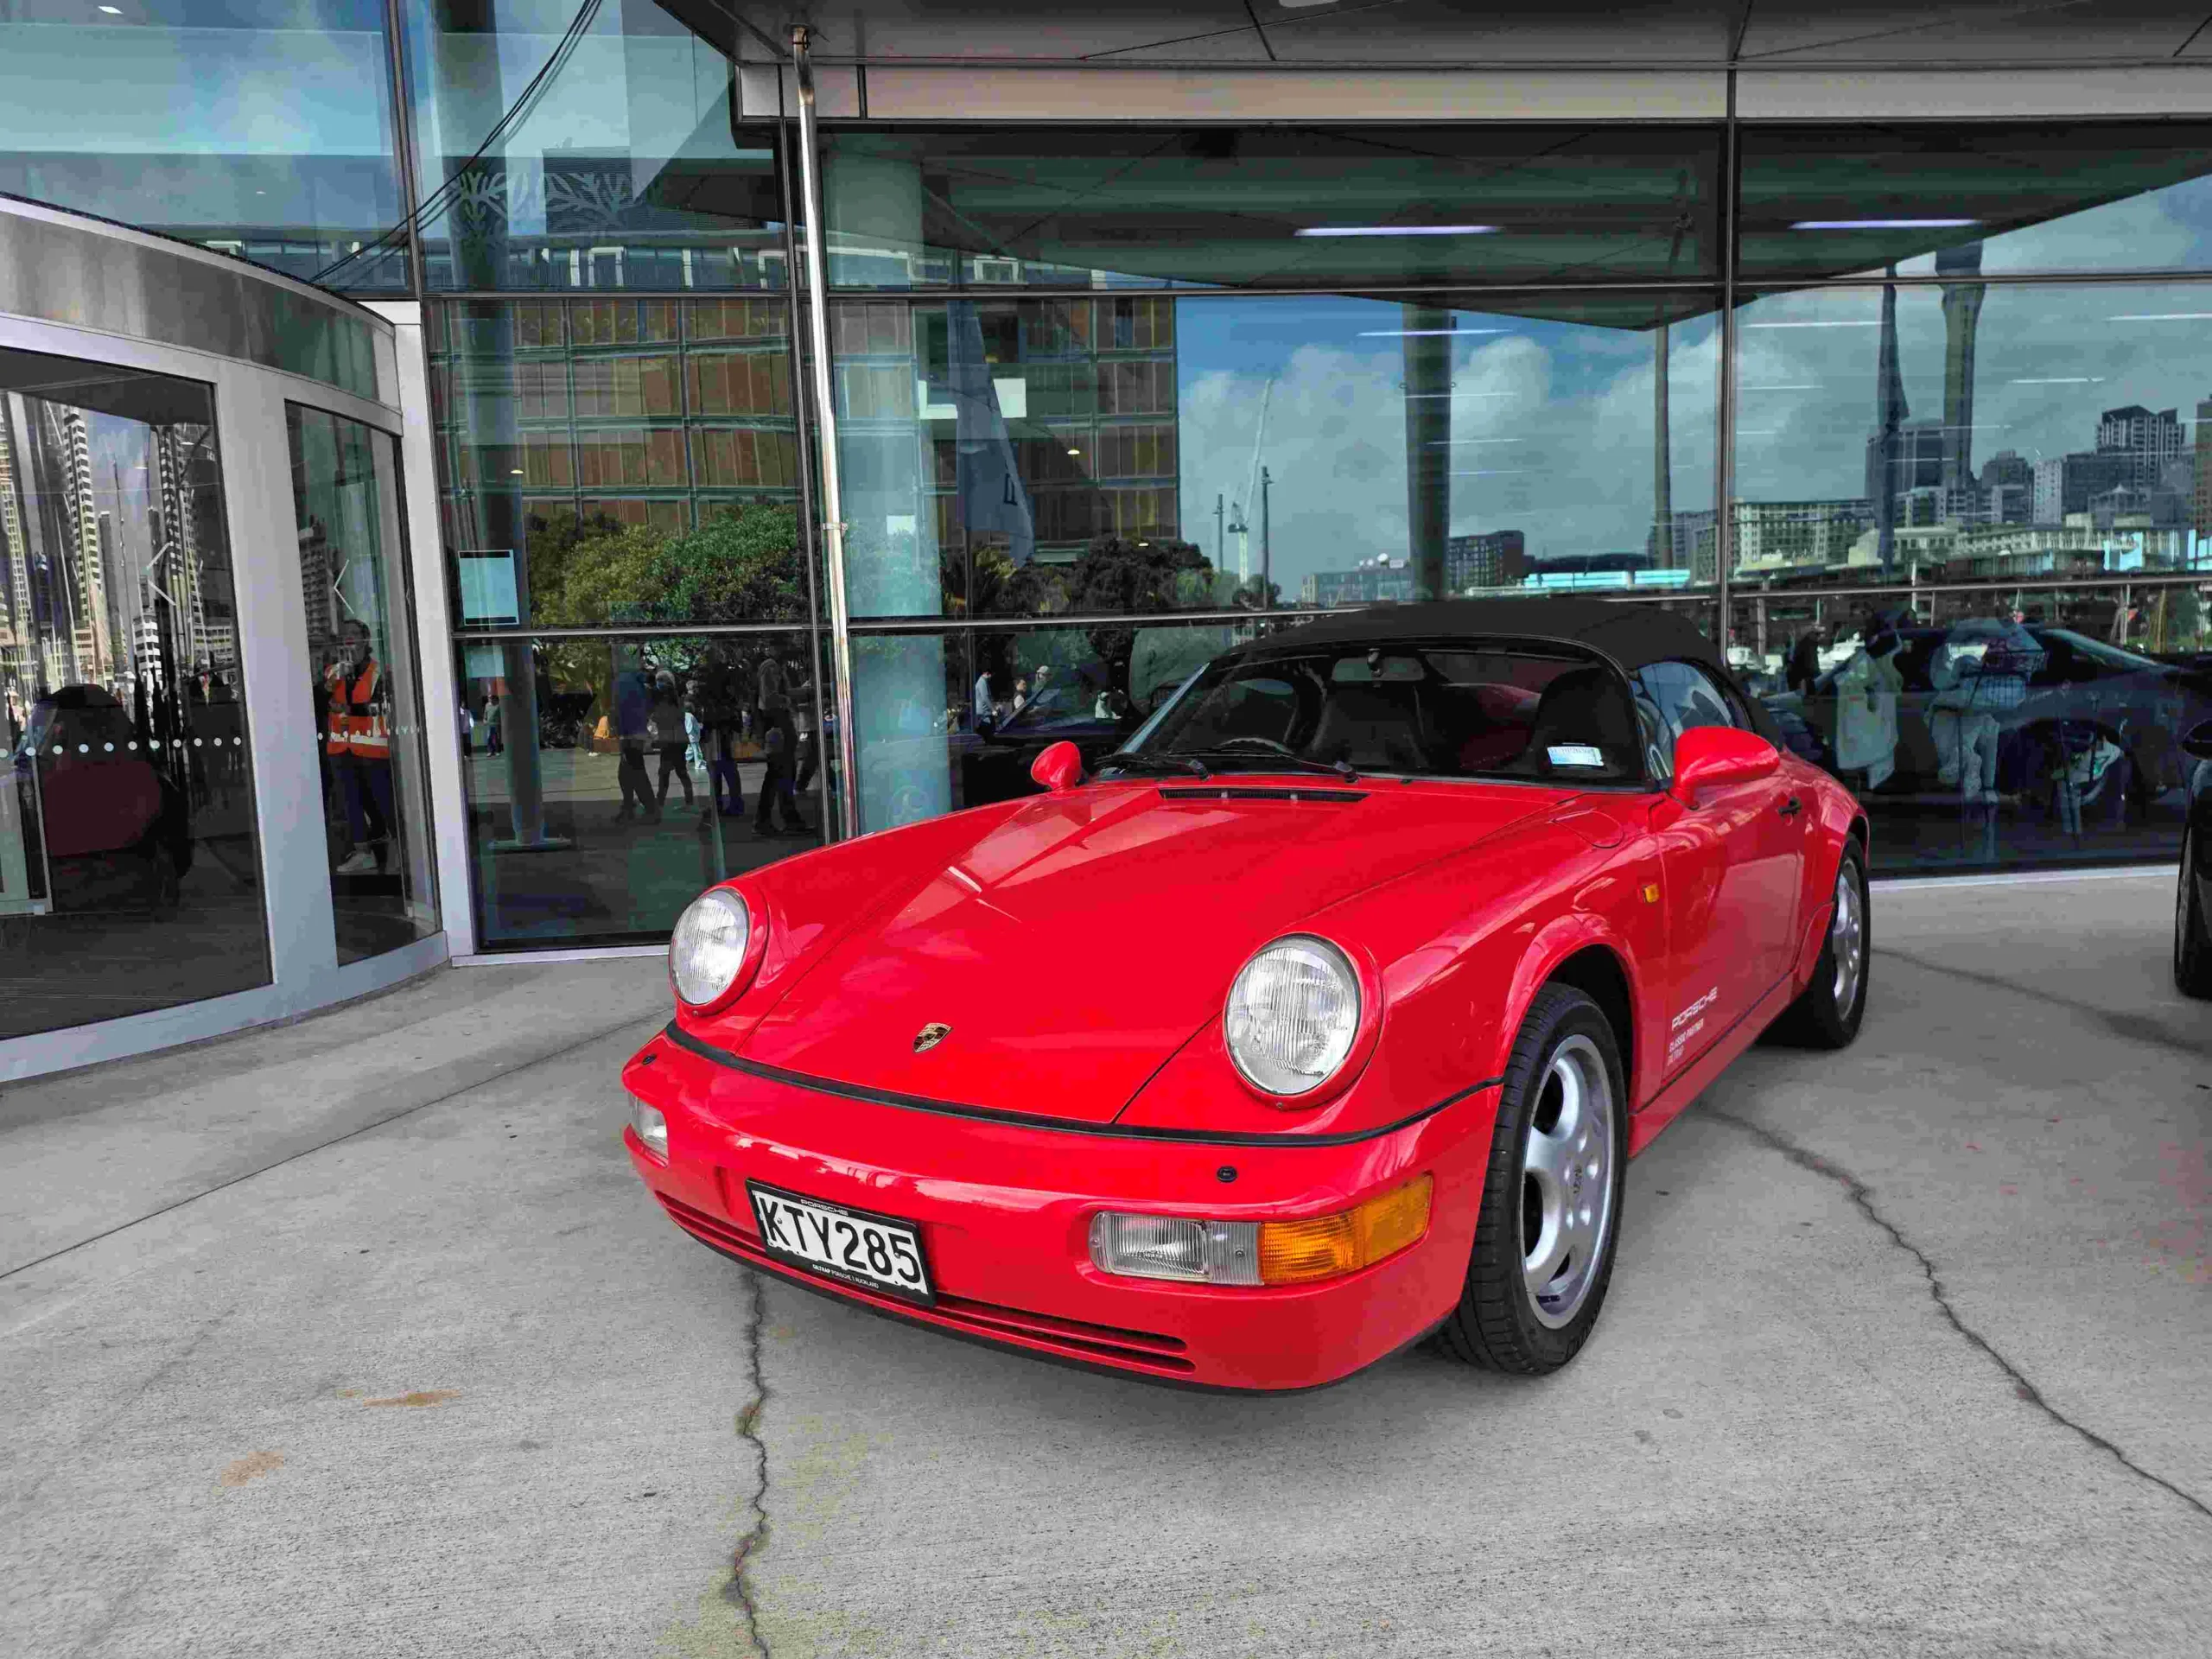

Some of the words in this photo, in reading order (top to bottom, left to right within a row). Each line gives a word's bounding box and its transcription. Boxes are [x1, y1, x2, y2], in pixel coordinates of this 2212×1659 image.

[1671, 986, 1718, 1031] PORSCHE
[800, 1198, 849, 1217] PORSCHE
[759, 1197, 921, 1284] KTY285
